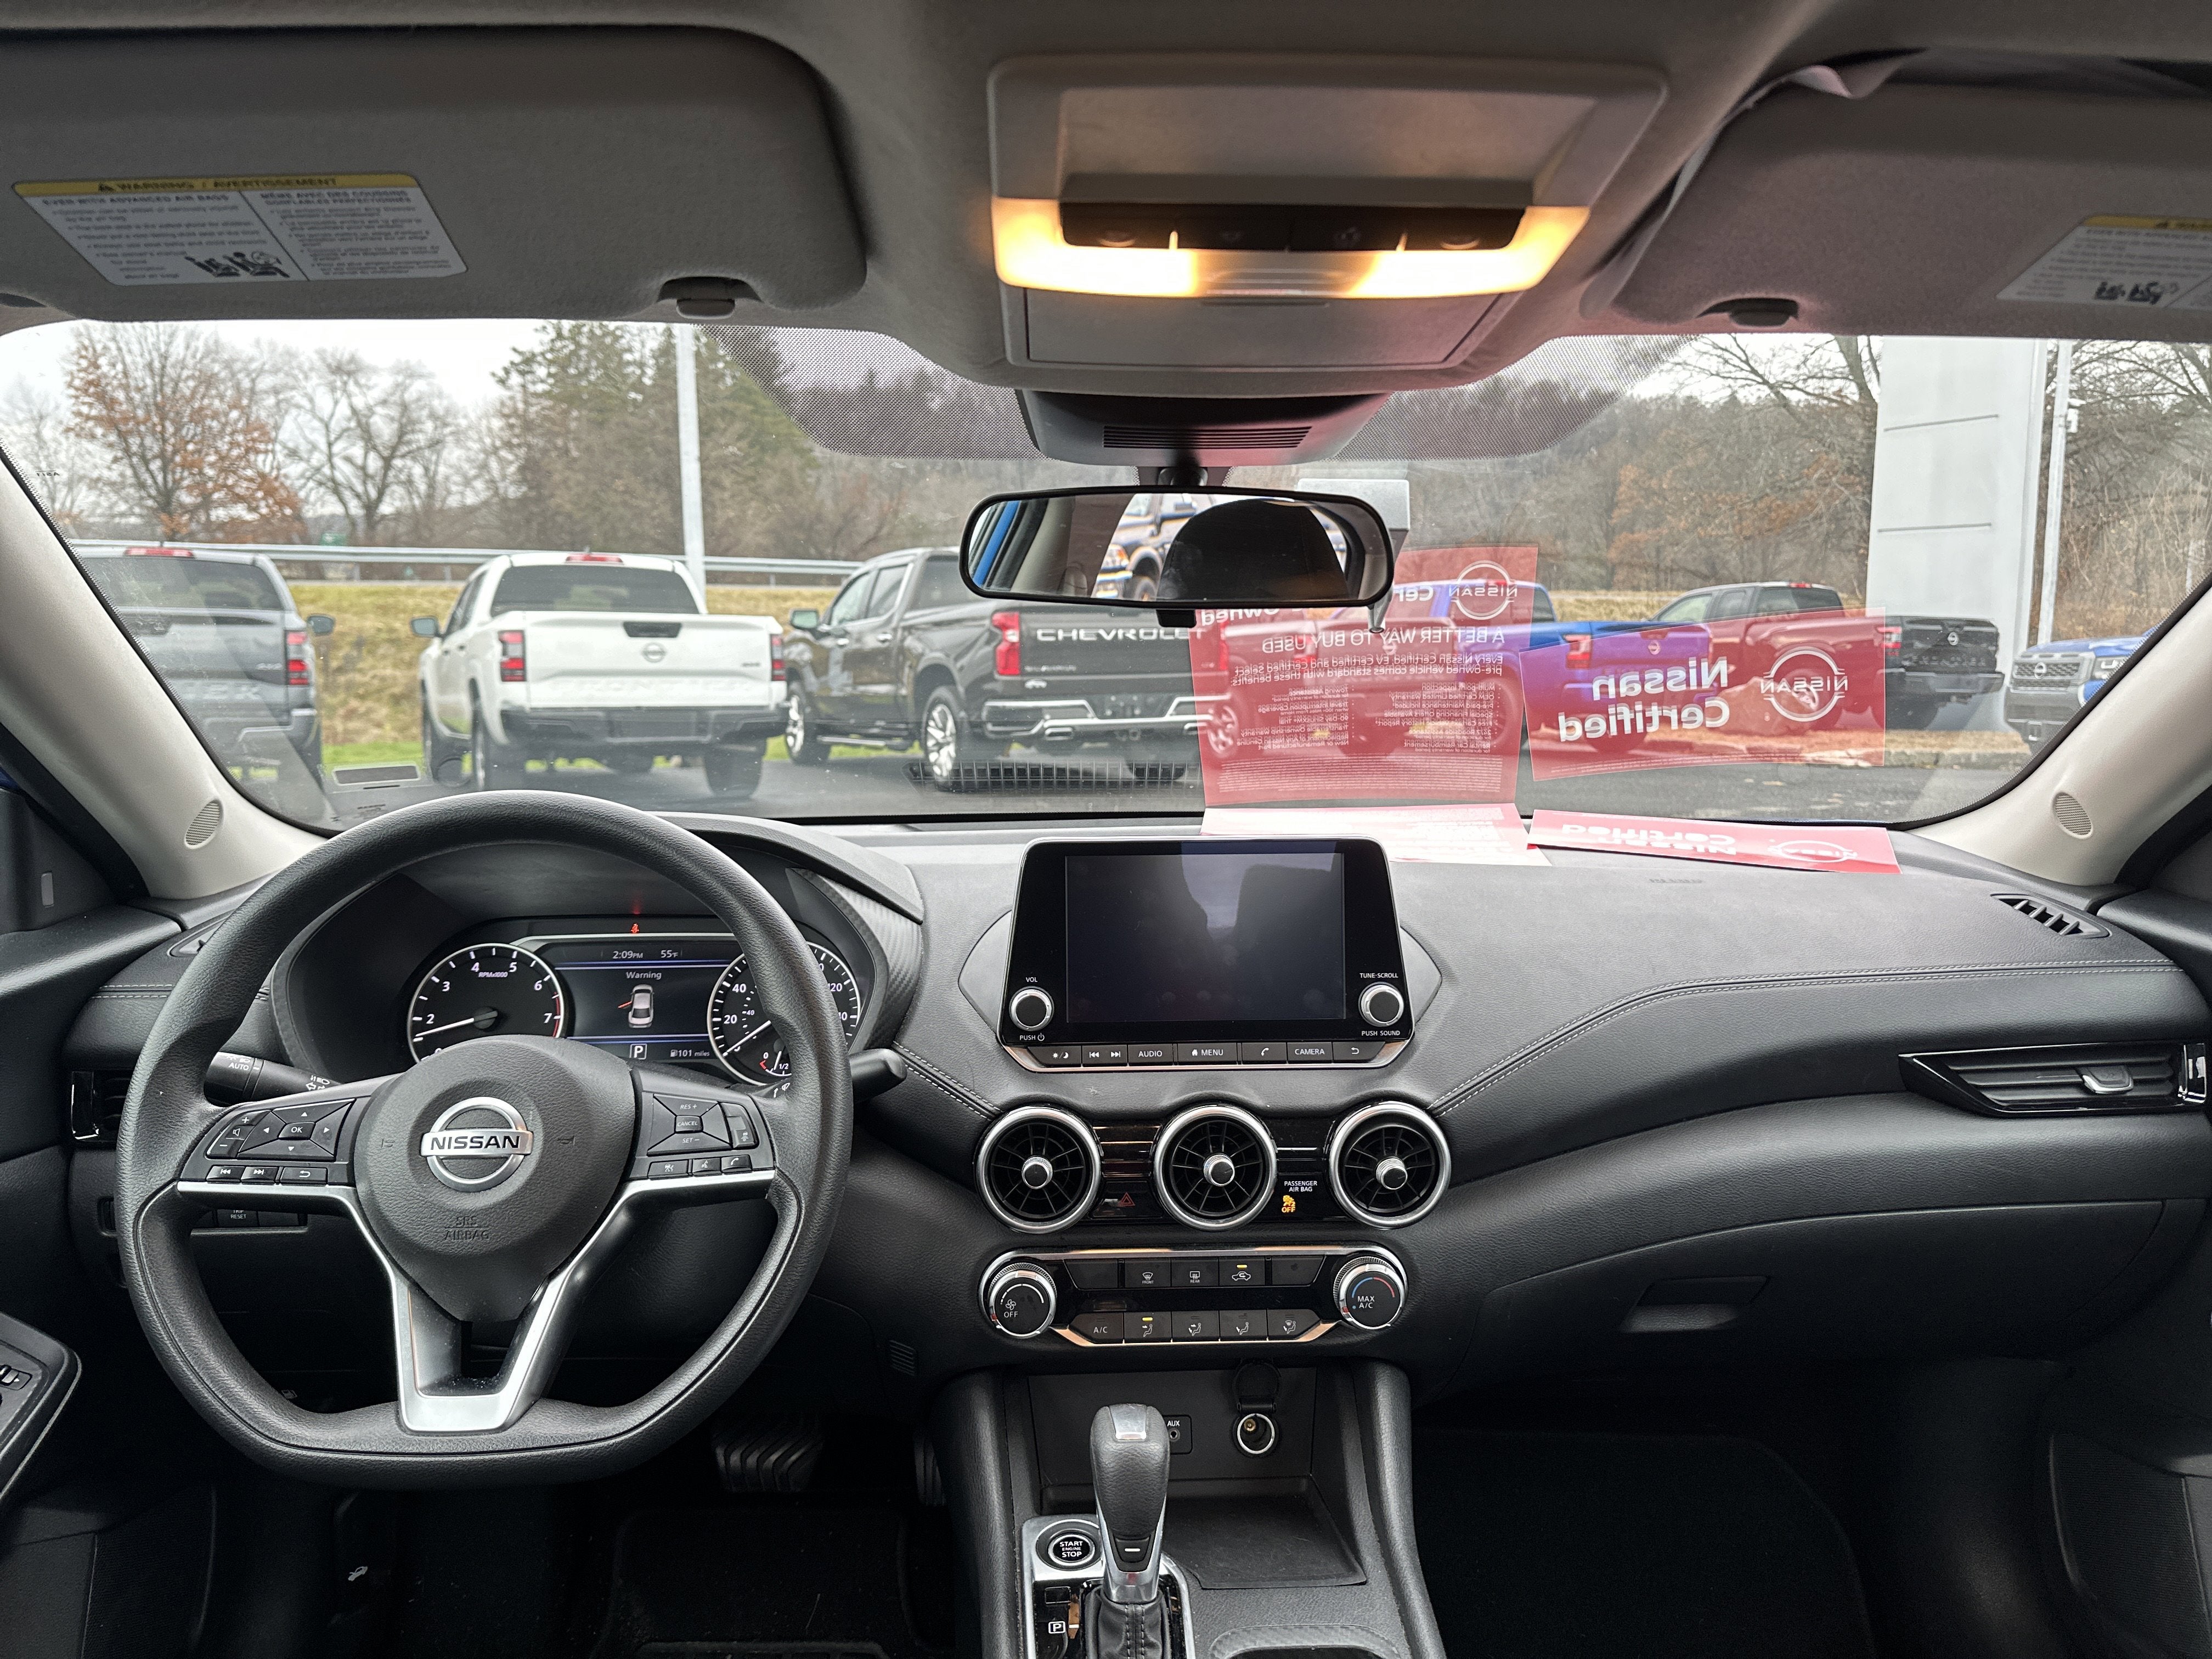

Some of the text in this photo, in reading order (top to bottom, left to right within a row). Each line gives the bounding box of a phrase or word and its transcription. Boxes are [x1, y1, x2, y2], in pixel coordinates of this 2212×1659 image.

[116, 182, 194, 190] WARNING
[1036, 628, 1204, 641] CHEVROLET
[471, 962, 479, 973] 4
[509, 962, 517, 973] 5
[625, 971, 662, 980] Warning
[442, 981, 450, 992] 3
[534, 980, 542, 991] 6
[732, 983, 747, 993] 40
[426, 1013, 435, 1024] 2
[544, 1012, 552, 1024] 7
[723, 1014, 737, 1024] 20
[634, 1045, 644, 1058] P
[678, 1049, 692, 1057] 101
[228, 1062, 250, 1071] AUTO
[431, 1136, 520, 1150] NISSAN
[444, 1229, 490, 1242] AIRBAG
[1053, 1623, 1062, 1632] P
